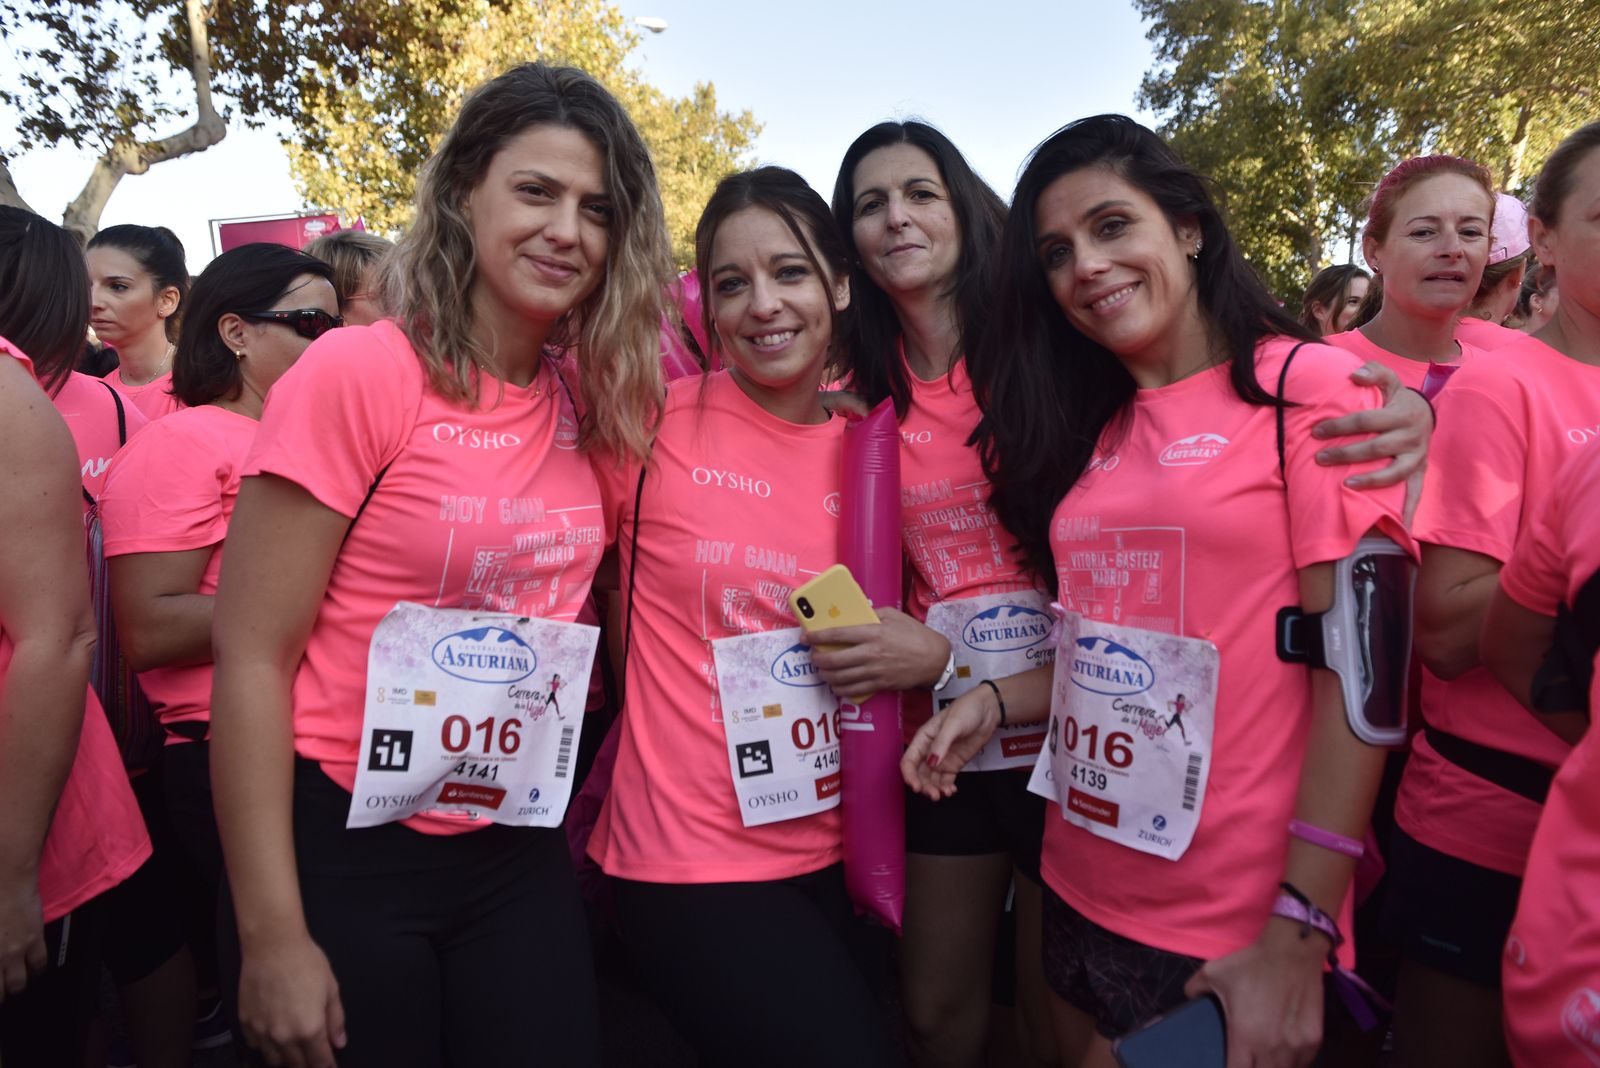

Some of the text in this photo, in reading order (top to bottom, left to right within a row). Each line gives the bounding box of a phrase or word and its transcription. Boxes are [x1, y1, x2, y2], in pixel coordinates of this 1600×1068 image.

[432, 423, 521, 450] OYSHO
[692, 467, 772, 498] OYSHO
[439, 494, 546, 525] HOY GANAN
[534, 545, 575, 565] MADRID
[695, 539, 798, 578] HOY GANAN
[969, 624, 1047, 644] ASTURIANA
[441, 643, 530, 672] ASTURIANA
[1072, 658, 1145, 688] STURIANA
[507, 684, 541, 701] Carrera
[1112, 697, 1157, 719] Carrera
[440, 714, 523, 755] 016
[1064, 715, 1135, 770] 016
[453, 761, 499, 782] 4141
[814, 748, 840, 771] 4140
[1071, 763, 1107, 792] 4139
[517, 806, 550, 817] ZURICH
[748, 789, 799, 810] OYSHO
[1137, 829, 1174, 848] ZURICH
